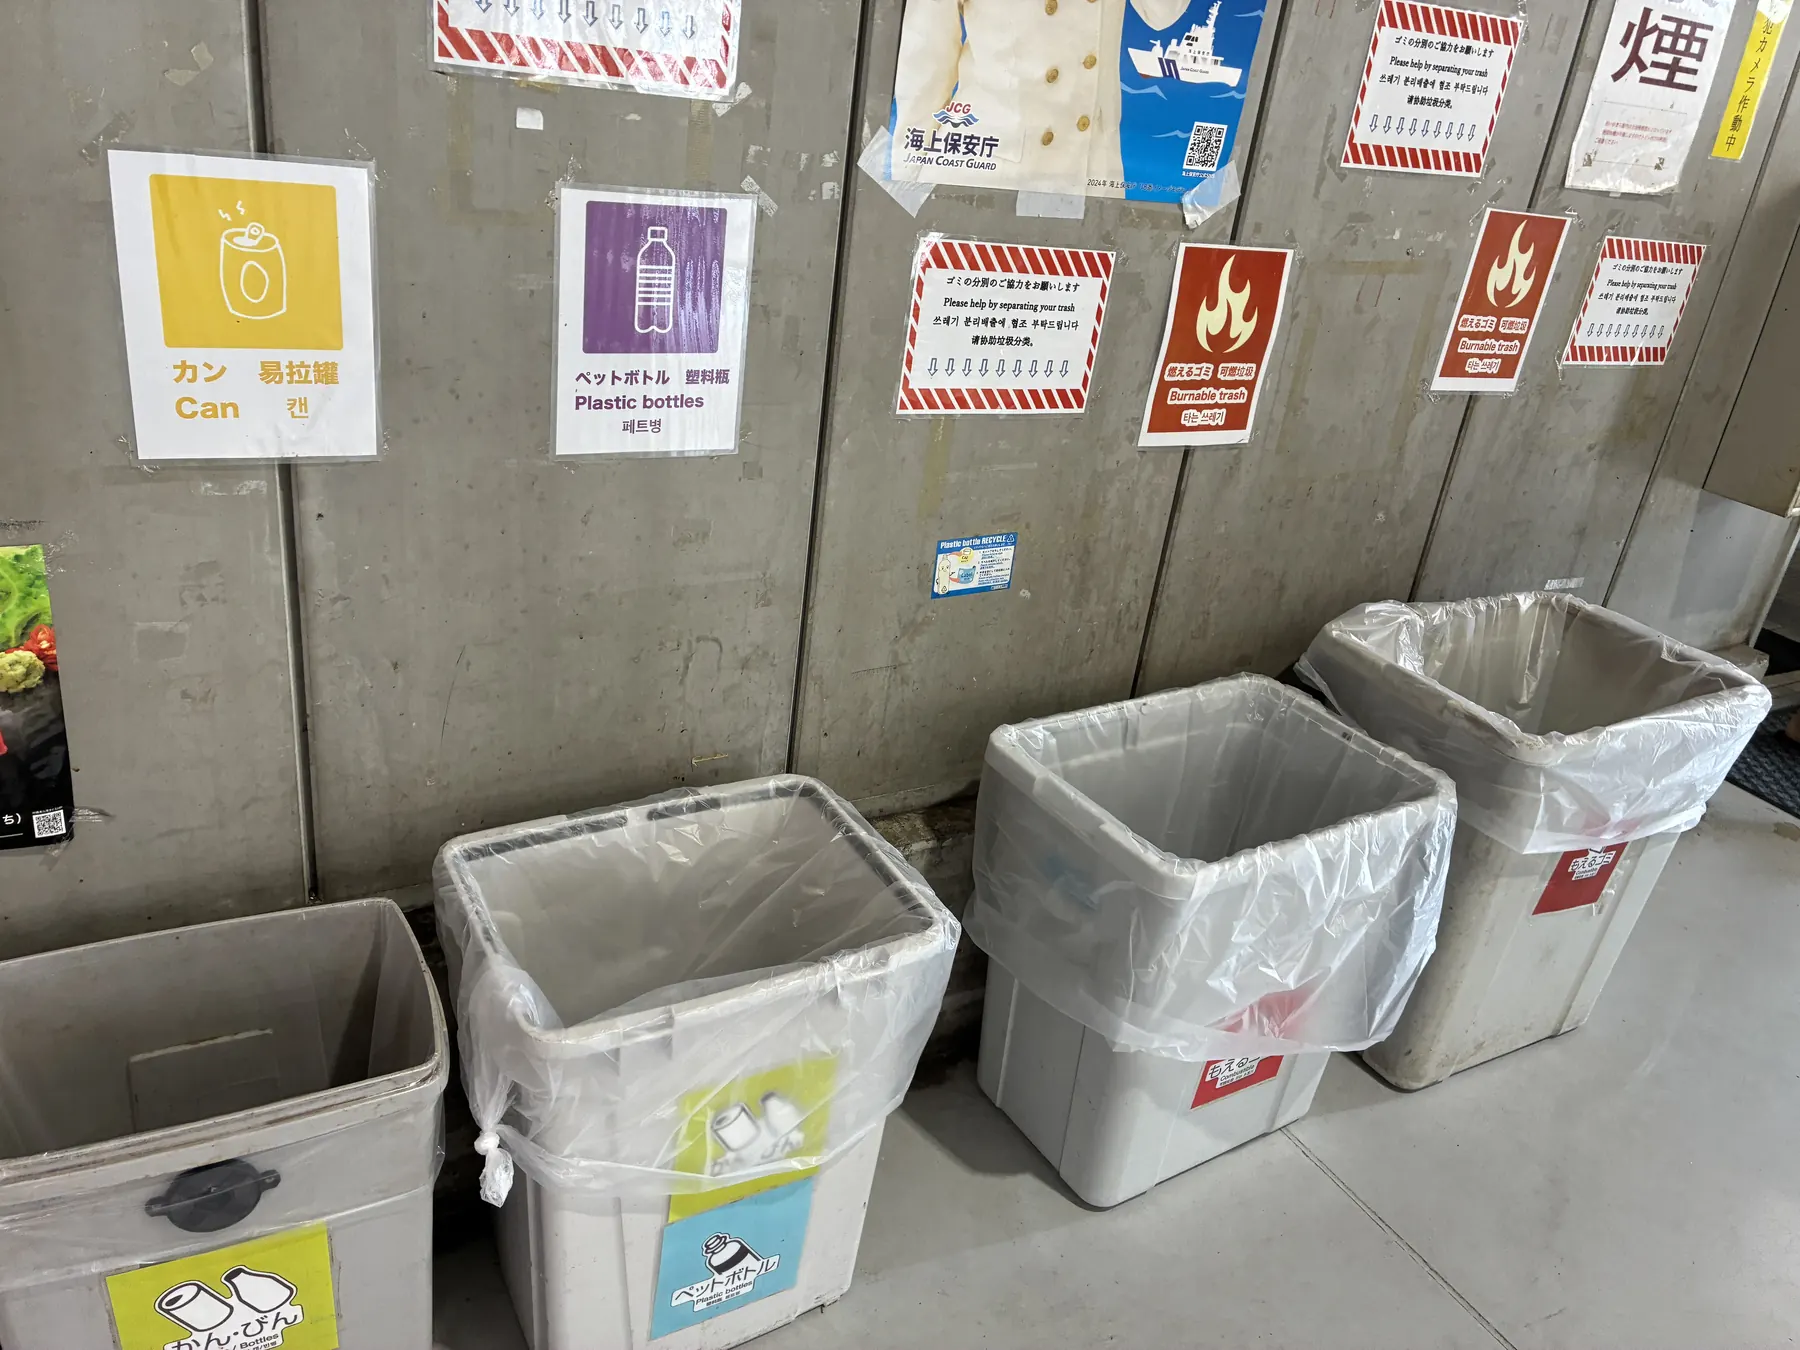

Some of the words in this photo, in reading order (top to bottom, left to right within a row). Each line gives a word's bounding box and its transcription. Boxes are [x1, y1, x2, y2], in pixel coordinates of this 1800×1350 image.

[1610, 6, 1714, 92] 煙
[1390, 56, 1409, 68] Please
[1410, 59, 1423, 70] help
[1424, 61, 1432, 72] by
[1432, 64, 1461, 76] separating
[1475, 69, 1488, 77] trash
[946, 102, 971, 114] JCG
[904, 128, 999, 158] 海上保安庁
[903, 153, 933, 164] JAPAN
[936, 156, 964, 167] COAST
[966, 158, 996, 170] GUARD
[946, 276, 1080, 292] ゴミの分別のご協力をお願いします
[943, 298, 968, 307] Please
[970, 299, 986, 310] help
[989, 300, 998, 310] by
[1000, 302, 1039, 312] separating
[1039, 304, 1056, 312] your
[1058, 303, 1075, 312] trash
[933, 316, 959, 327] 쓰레기
[964, 316, 1006, 328] 분리배출에
[1011, 318, 1027, 328] 협조
[1032, 320, 1078, 330] 부탁드립니다
[1460, 318, 1495, 329] 燃えるゴミ
[1460, 341, 1496, 351] Burnable
[1498, 342, 1518, 352] trash
[172, 360, 227, 384] カン
[258, 360, 340, 385] 易拉罐
[575, 370, 670, 386] ペットボトル
[685, 369, 730, 385] 塑料瓶
[1167, 366, 1211, 378] 燃えるゴミ
[1220, 366, 1254, 377] 可燃垃圾
[575, 395, 637, 410] Plastic
[643, 394, 704, 409] bottles
[1170, 390, 1216, 401] Burnable
[1219, 390, 1245, 400] trash
[174, 396, 240, 419] Can
[287, 396, 309, 419] 캔
[1184, 411, 1199, 423] 타는
[1201, 412, 1224, 423] 쓰레기
[622, 418, 662, 434] 페트병
[982, 534, 1006, 544] RECYCLE
[1571, 853, 1613, 871] もえるゴミ
[1209, 1057, 1260, 1078] もえる
[675, 1258, 776, 1300] ペットボトル
[696, 1292, 723, 1305] Plastic
[725, 1281, 752, 1294] bottles
[240, 1334, 279, 1349] Bottles
